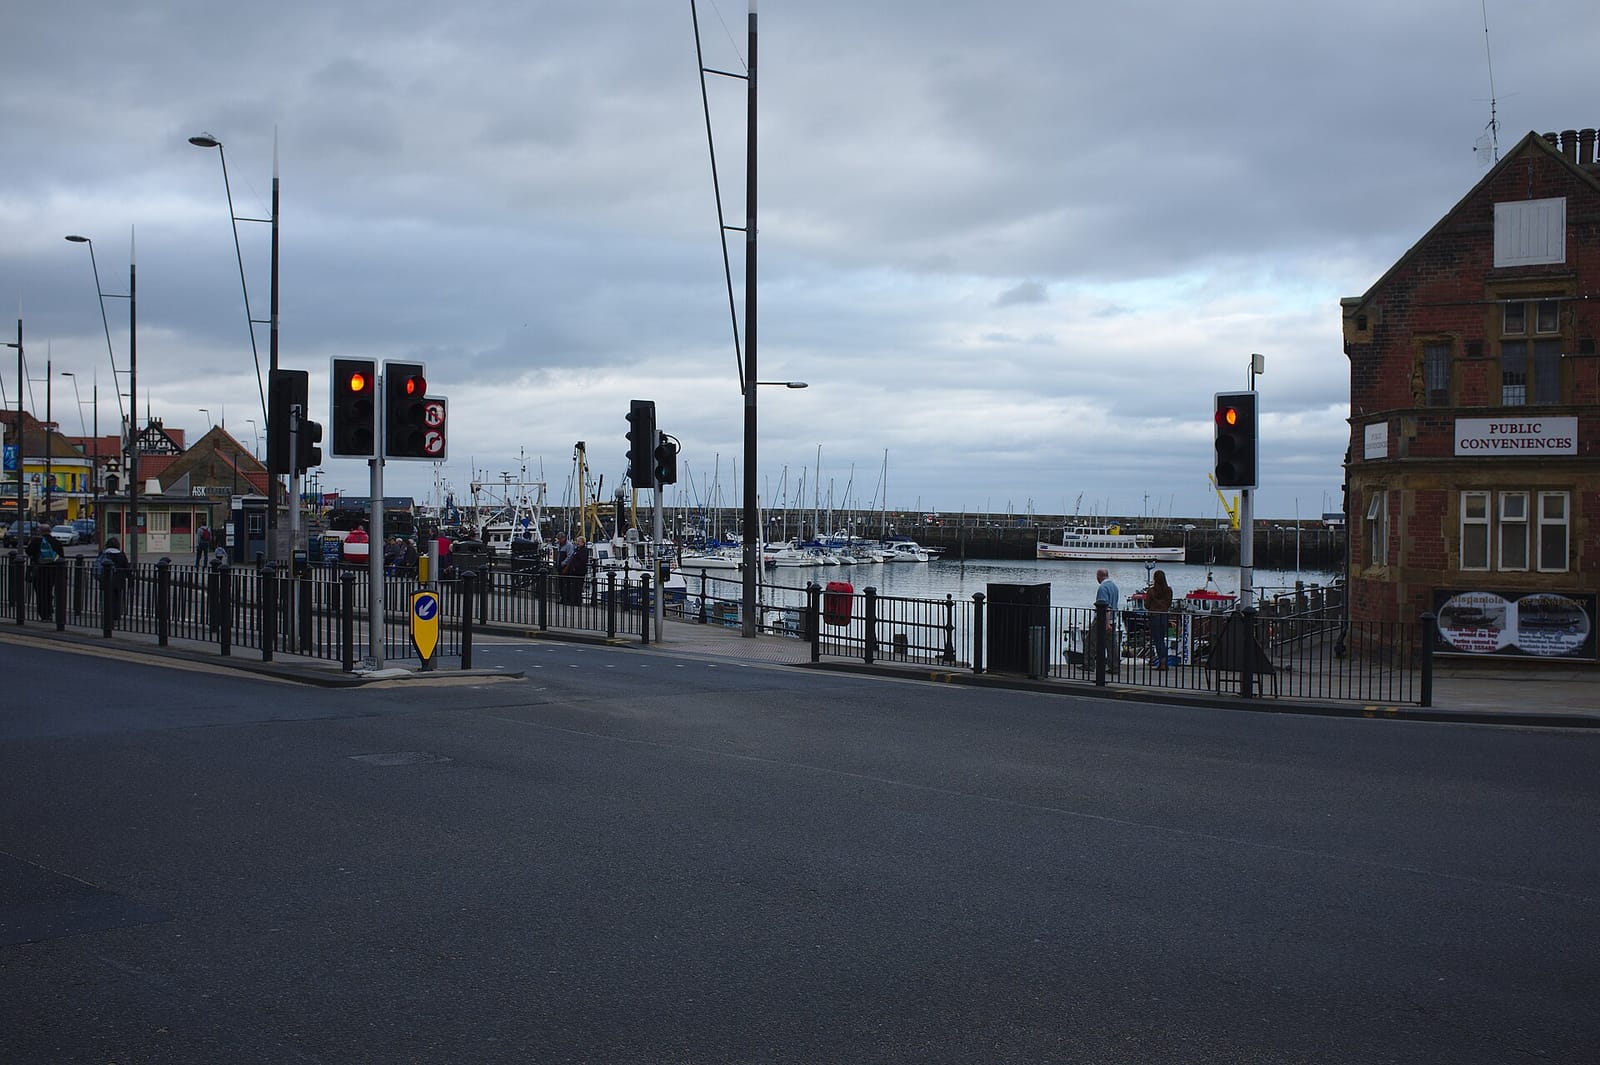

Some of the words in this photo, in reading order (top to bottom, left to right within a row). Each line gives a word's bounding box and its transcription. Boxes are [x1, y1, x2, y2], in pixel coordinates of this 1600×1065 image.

[1489, 423, 1542, 434] PUBLIC
[1460, 438, 1572, 449] CONVENIENCES
[191, 486, 206, 496] ASK
